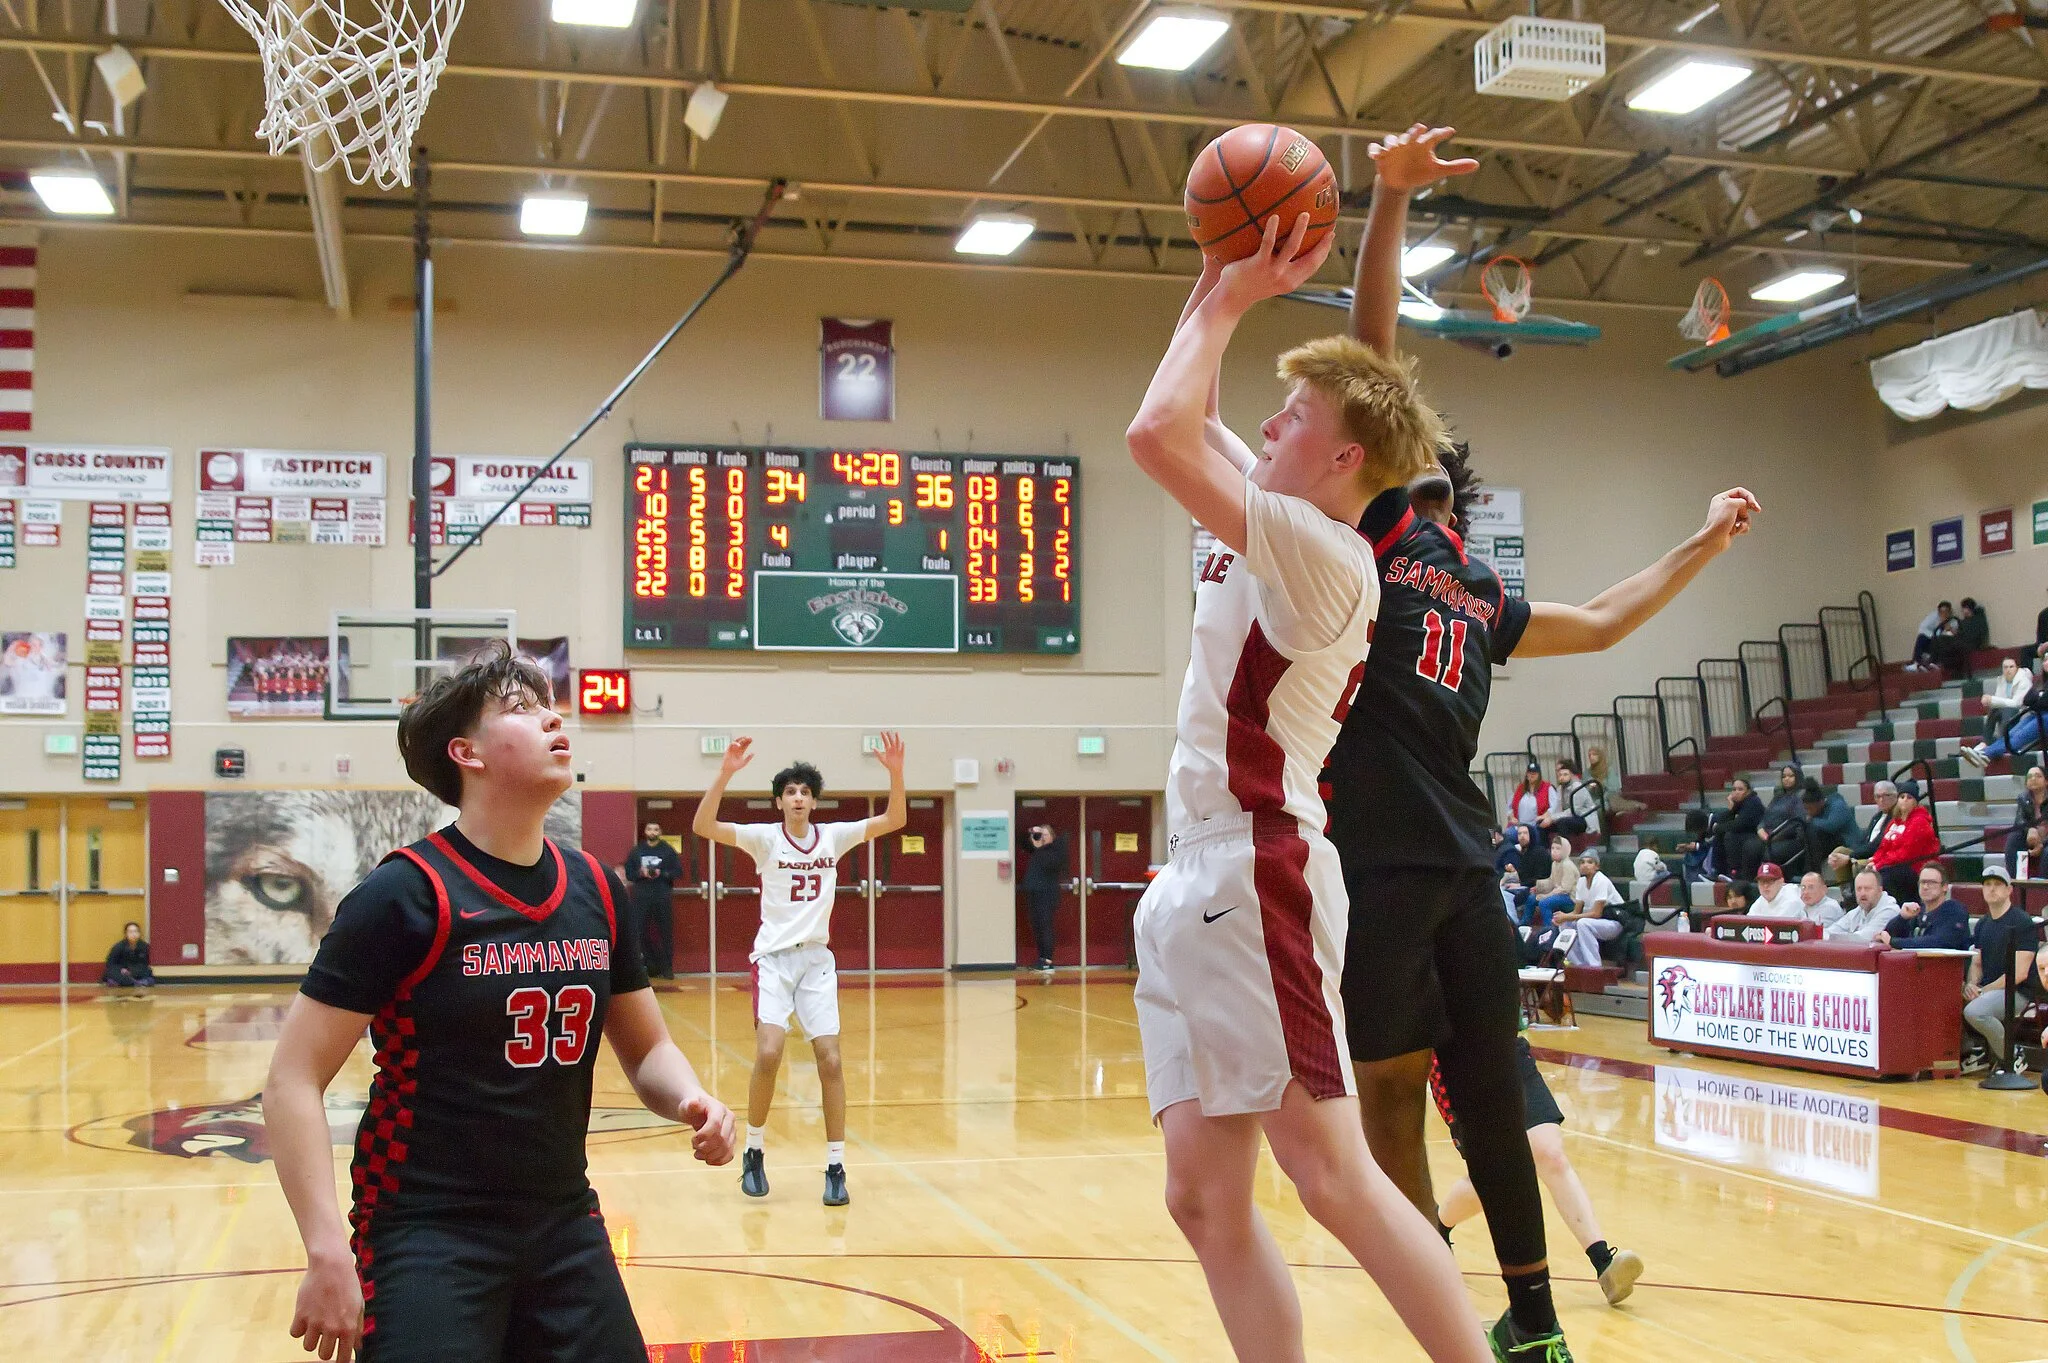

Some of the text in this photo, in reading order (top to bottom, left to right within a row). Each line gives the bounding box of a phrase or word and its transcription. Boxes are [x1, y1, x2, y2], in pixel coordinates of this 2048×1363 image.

[838, 353, 876, 380] 22
[34, 453, 165, 469] CROSS COUNTRY
[262, 458, 372, 474] FASTPITCH
[631, 449, 747, 466] player points fouls
[765, 452, 799, 467] Home
[833, 453, 900, 486] 4:28
[911, 456, 952, 472] Guests
[963, 459, 1072, 477] player points fouls
[52, 472, 147, 483] CHAMPIONS
[270, 479, 362, 489] CHAMPIONS
[636, 466, 744, 494] 21 5 0
[767, 469, 806, 504] 34
[968, 476, 1069, 503] 03 8 2
[916, 474, 954, 508] 36
[645, 493, 744, 520] 10 2 0
[838, 504, 876, 521] period
[888, 499, 903, 525] 3
[968, 501, 1069, 528] 01 6 1
[559, 514, 589, 526] 2021
[636, 519, 744, 546] 25 5 3
[316, 534, 344, 543] 2011
[771, 525, 788, 548] 4
[940, 529, 947, 551] 1
[968, 527, 1069, 552] 04 7 2
[636, 545, 743, 571] 23 8 0
[762, 552, 791, 567] fouls
[837, 553, 877, 570] player
[922, 555, 951, 570] fouls
[968, 552, 1069, 579] 21 3 2
[636, 571, 743, 598] 22 0 2
[828, 578, 885, 587] Home of the
[1499, 568, 1521, 576] 2014
[807, 588, 908, 614] Eastlake
[969, 577, 1069, 603] 33 5 1
[1416, 608, 1468, 693] 11
[583, 675, 625, 709] 24
[778, 857, 835, 870] EASTLAKE
[1762, 864, 1770, 873] E
[791, 874, 822, 901] 23
[463, 939, 610, 976] SAMMAMISH
[1753, 971, 1804, 985] WELCOME TO
[1693, 983, 1872, 1034] EASTLAKE HIGH SCHOOL
[505, 985, 596, 1068] 33
[1697, 1021, 1869, 1058] HOME OF THE WOLVES
